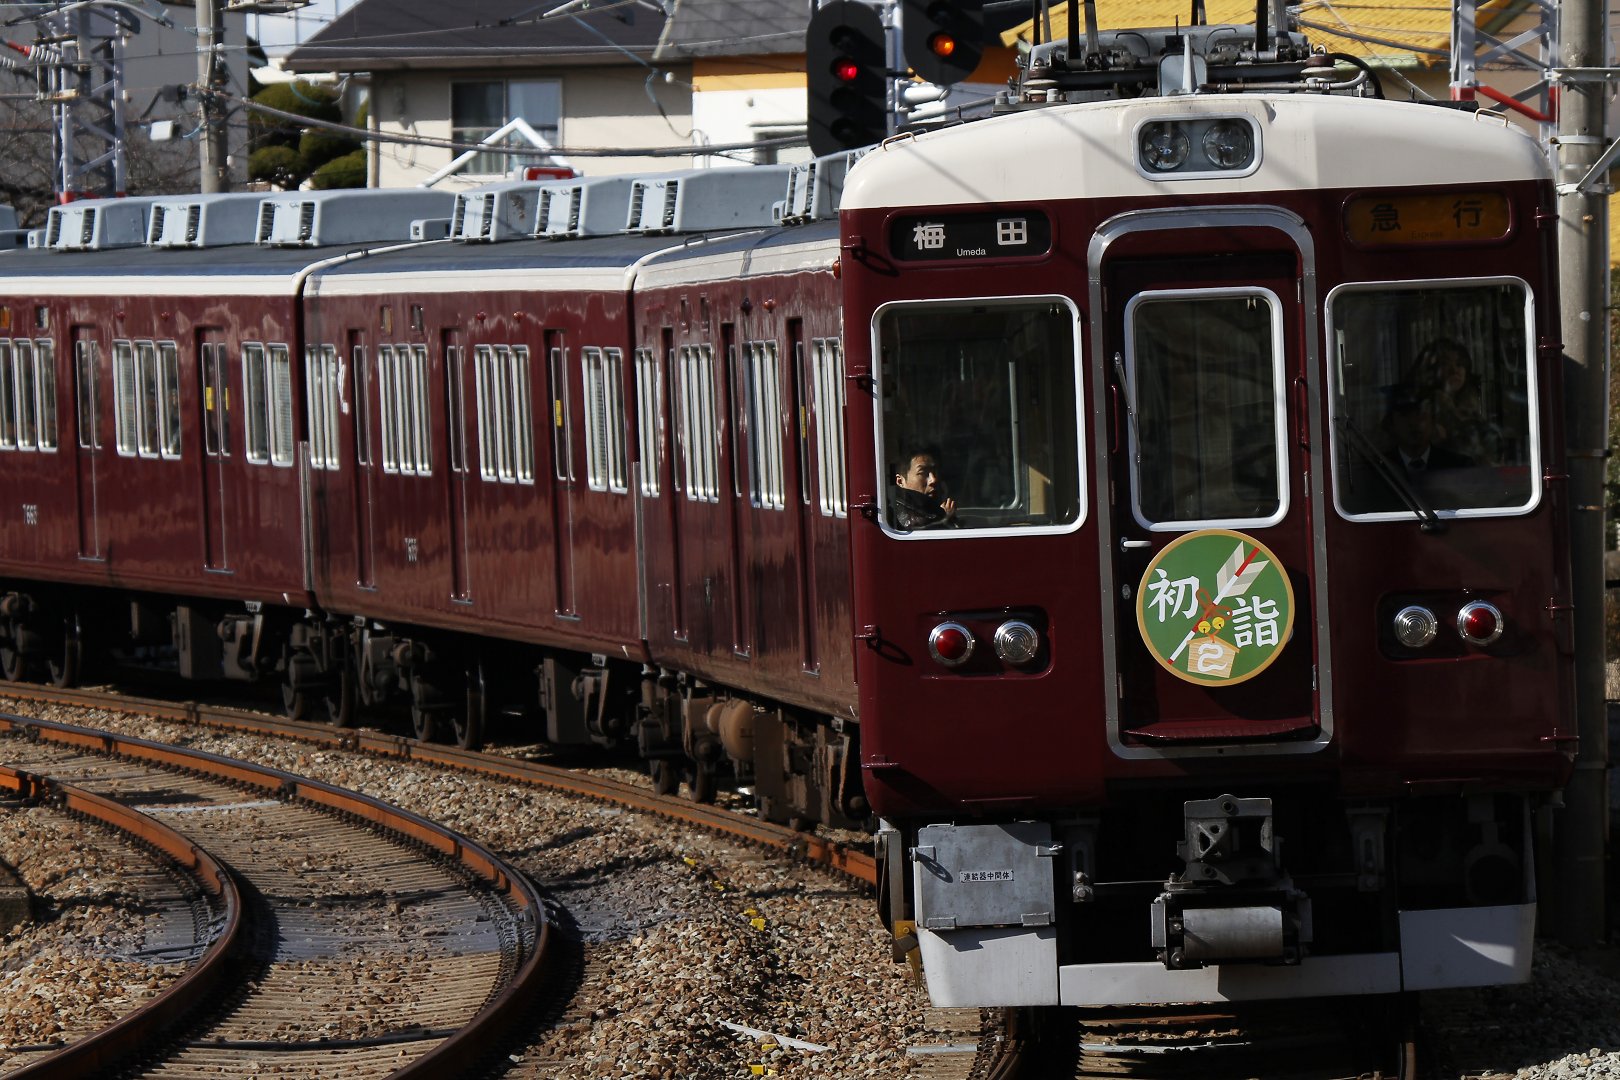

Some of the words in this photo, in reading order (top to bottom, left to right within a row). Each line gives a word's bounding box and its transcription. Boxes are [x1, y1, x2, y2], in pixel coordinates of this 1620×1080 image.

[1370, 199, 1483, 232] 急行
[913, 218, 1027, 250] 梅田
[956, 248, 987, 257] Umeda
[1147, 568, 1280, 648] 初詣
